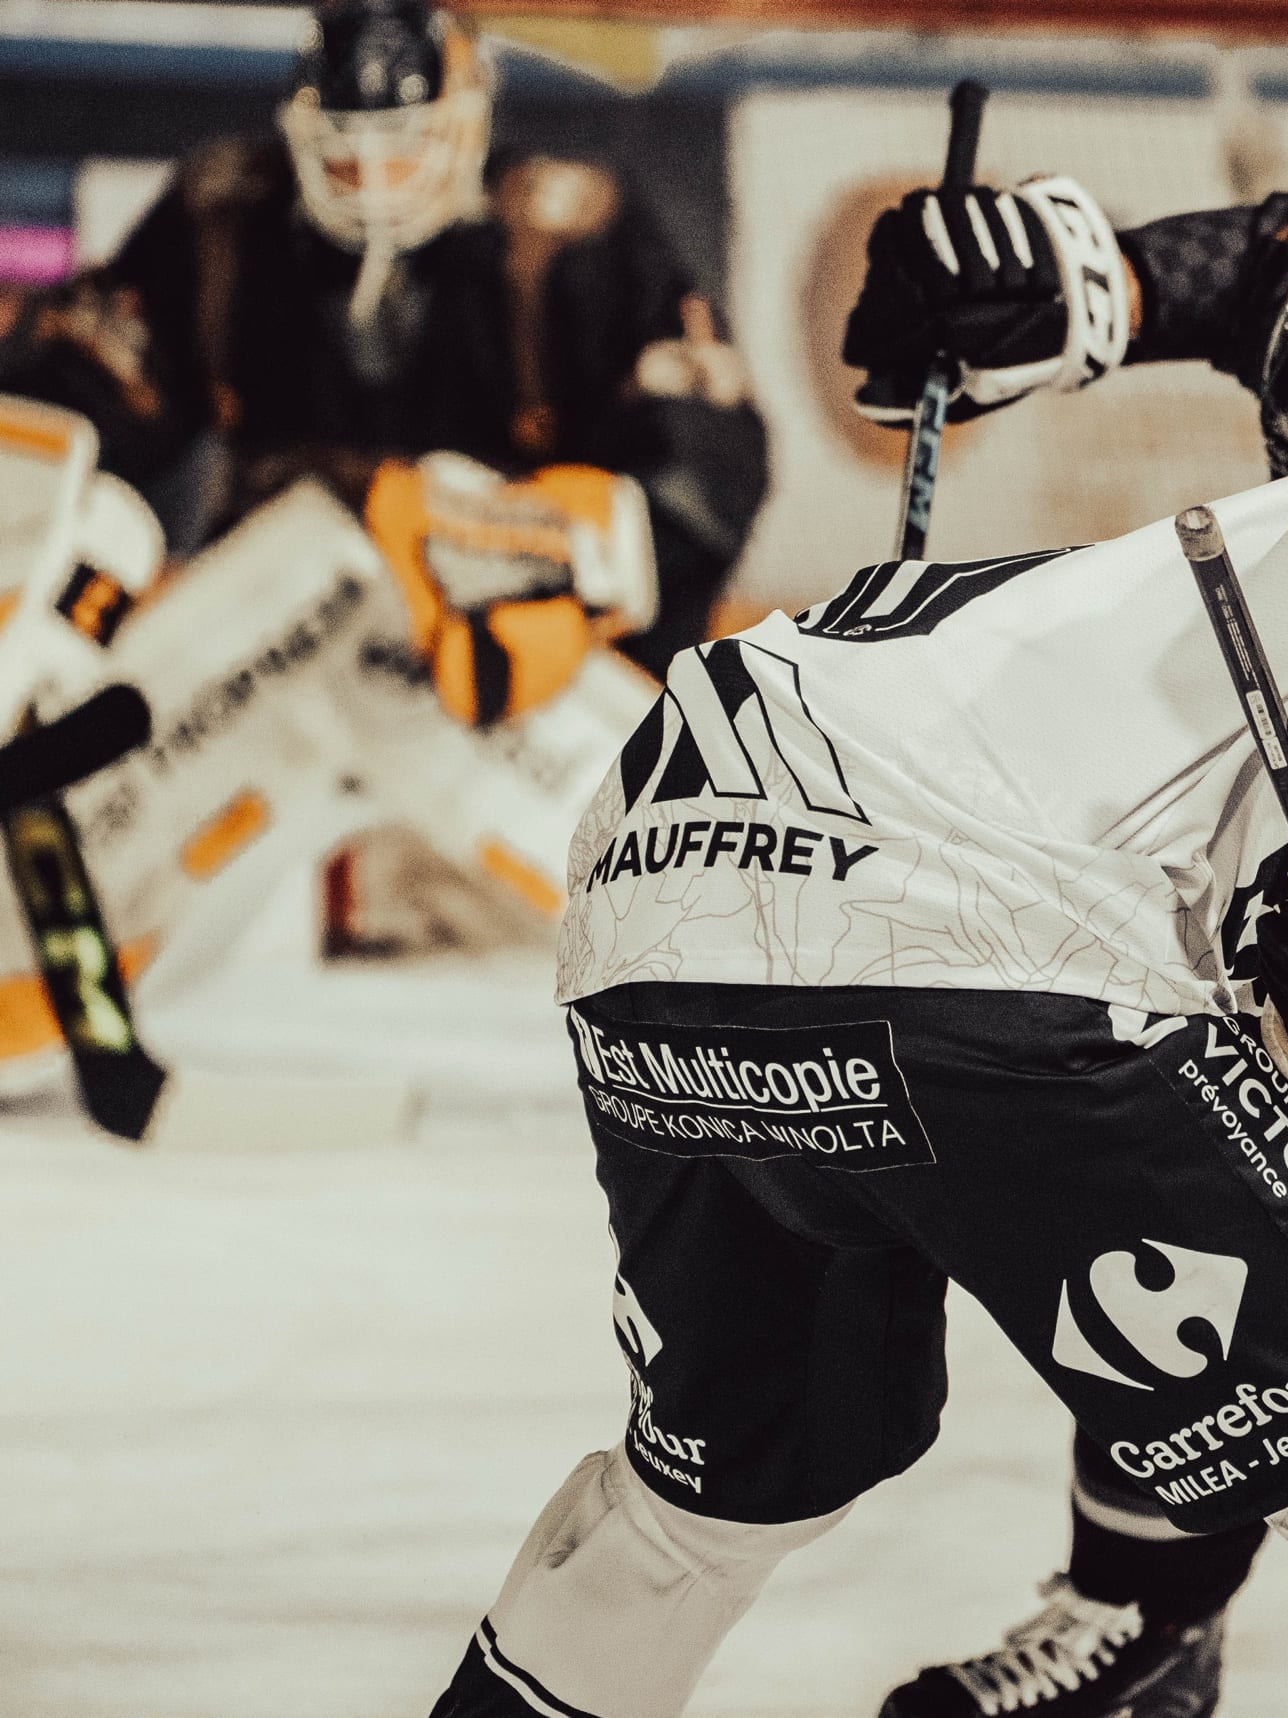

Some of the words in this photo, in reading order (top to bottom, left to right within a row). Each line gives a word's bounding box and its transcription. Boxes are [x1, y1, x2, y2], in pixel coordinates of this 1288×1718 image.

[587, 821, 880, 893] MAUFFREY
[591, 1025, 650, 1090] Est
[639, 1042, 881, 1113] Multicopie
[588, 1085, 665, 1136] GROUPE
[666, 1113, 766, 1144] KONICA
[1178, 1059, 1288, 1198] prévoyance
[1154, 1459, 1248, 1506] MILEA
